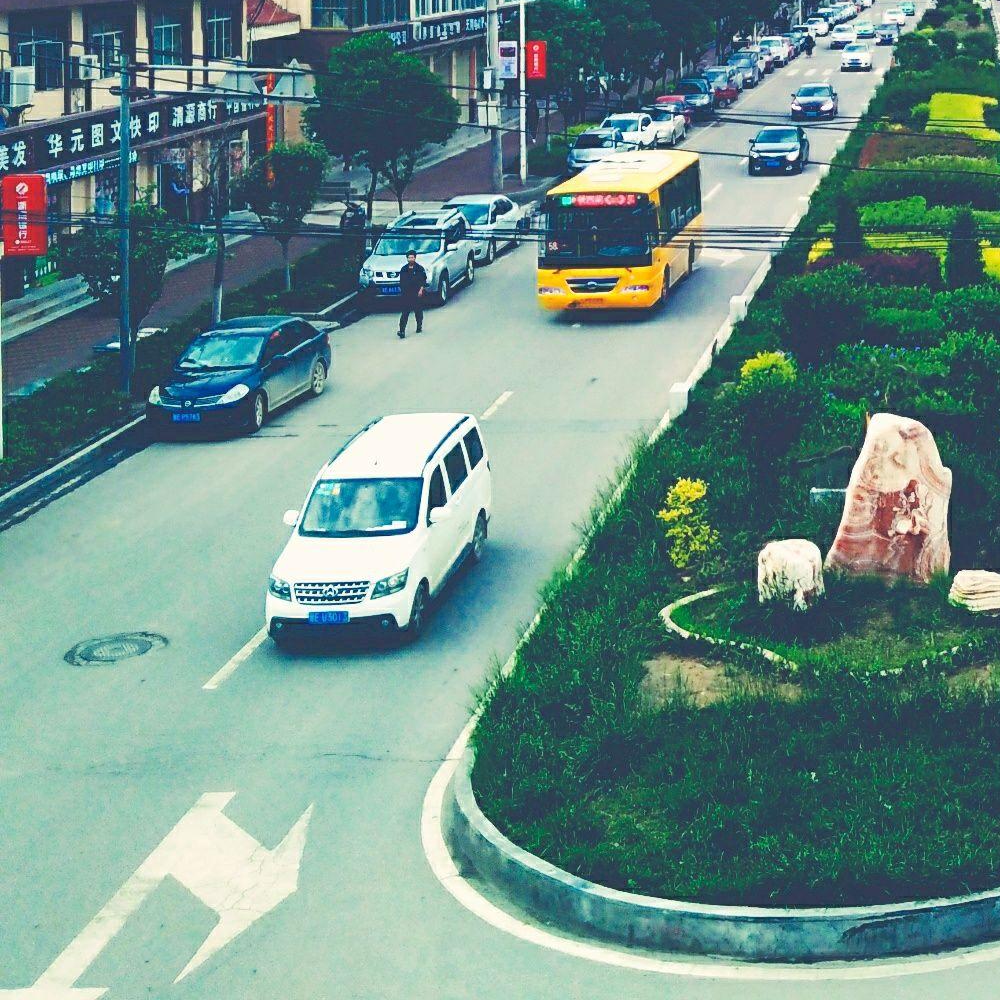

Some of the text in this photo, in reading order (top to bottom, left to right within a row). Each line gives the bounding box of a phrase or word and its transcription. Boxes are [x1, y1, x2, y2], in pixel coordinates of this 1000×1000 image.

[46, 111, 160, 158] 华元图文快印
